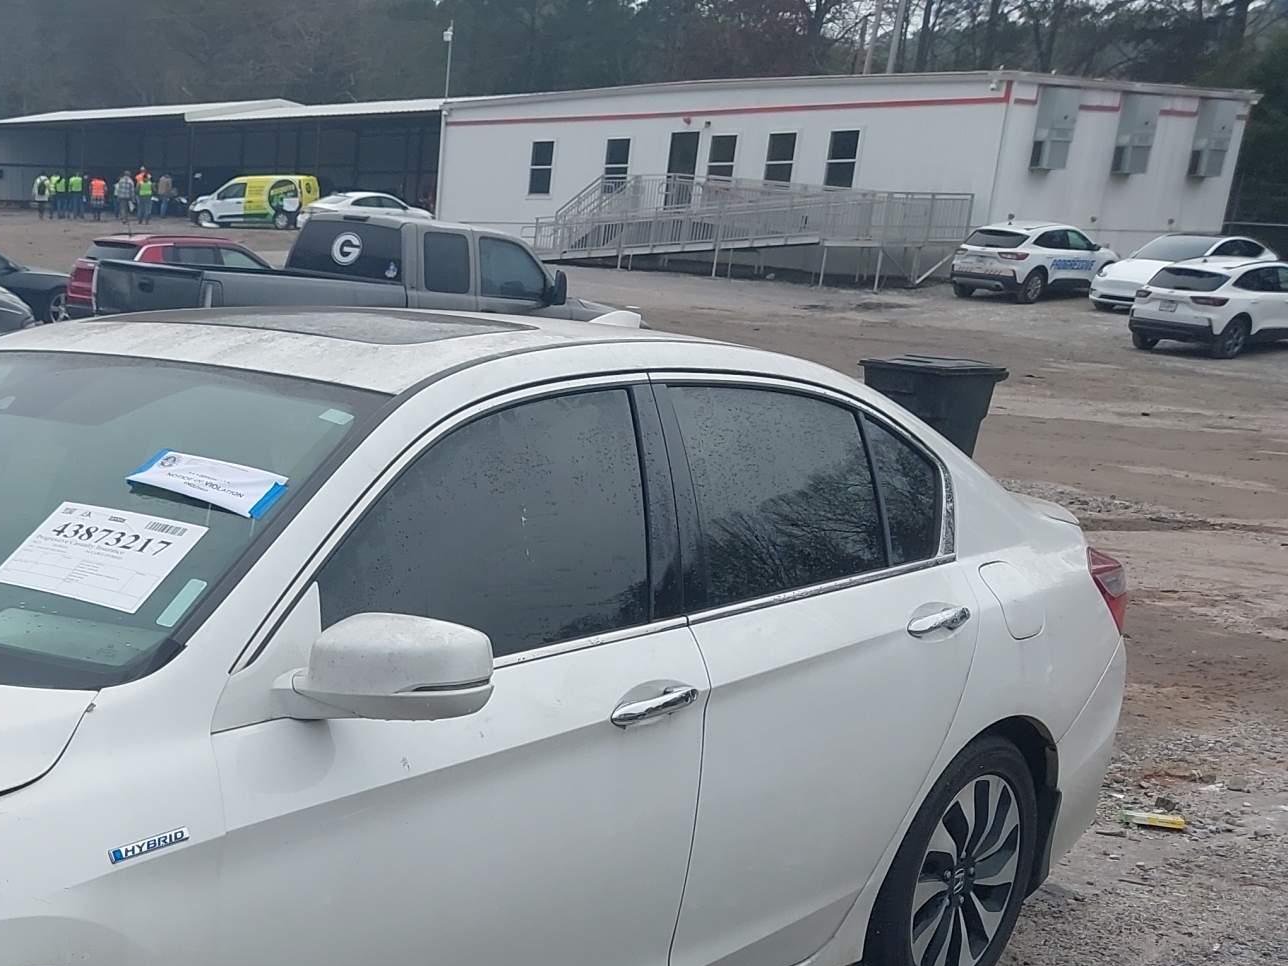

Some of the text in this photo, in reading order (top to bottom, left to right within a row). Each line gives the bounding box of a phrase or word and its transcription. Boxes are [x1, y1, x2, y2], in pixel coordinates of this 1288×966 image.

[332, 231, 363, 266] G
[204, 479, 245, 499] VIOLATION
[52, 521, 173, 557] 43873217
[124, 829, 186, 857] HYBRID
